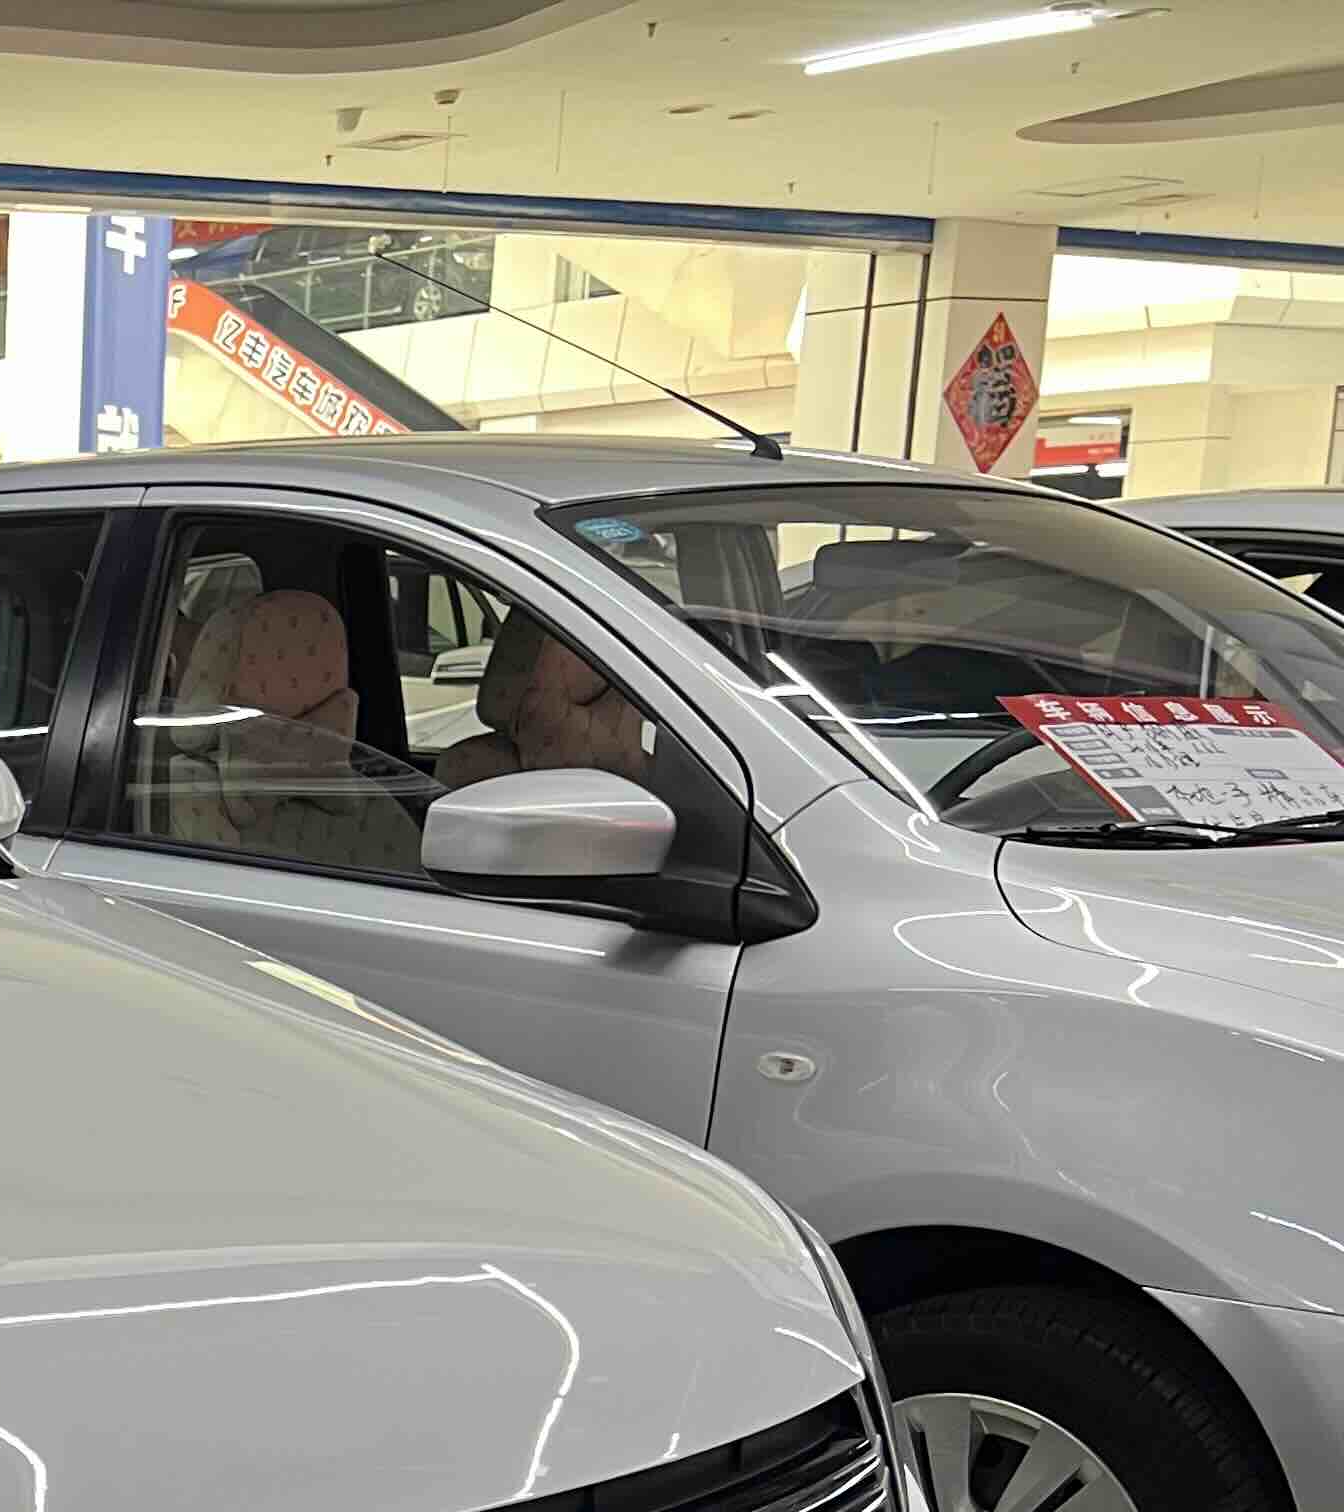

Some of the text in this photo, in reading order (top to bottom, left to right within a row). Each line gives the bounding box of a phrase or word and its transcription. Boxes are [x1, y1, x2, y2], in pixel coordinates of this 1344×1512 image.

[217, 312, 394, 435] 亿丰汽车城欢
